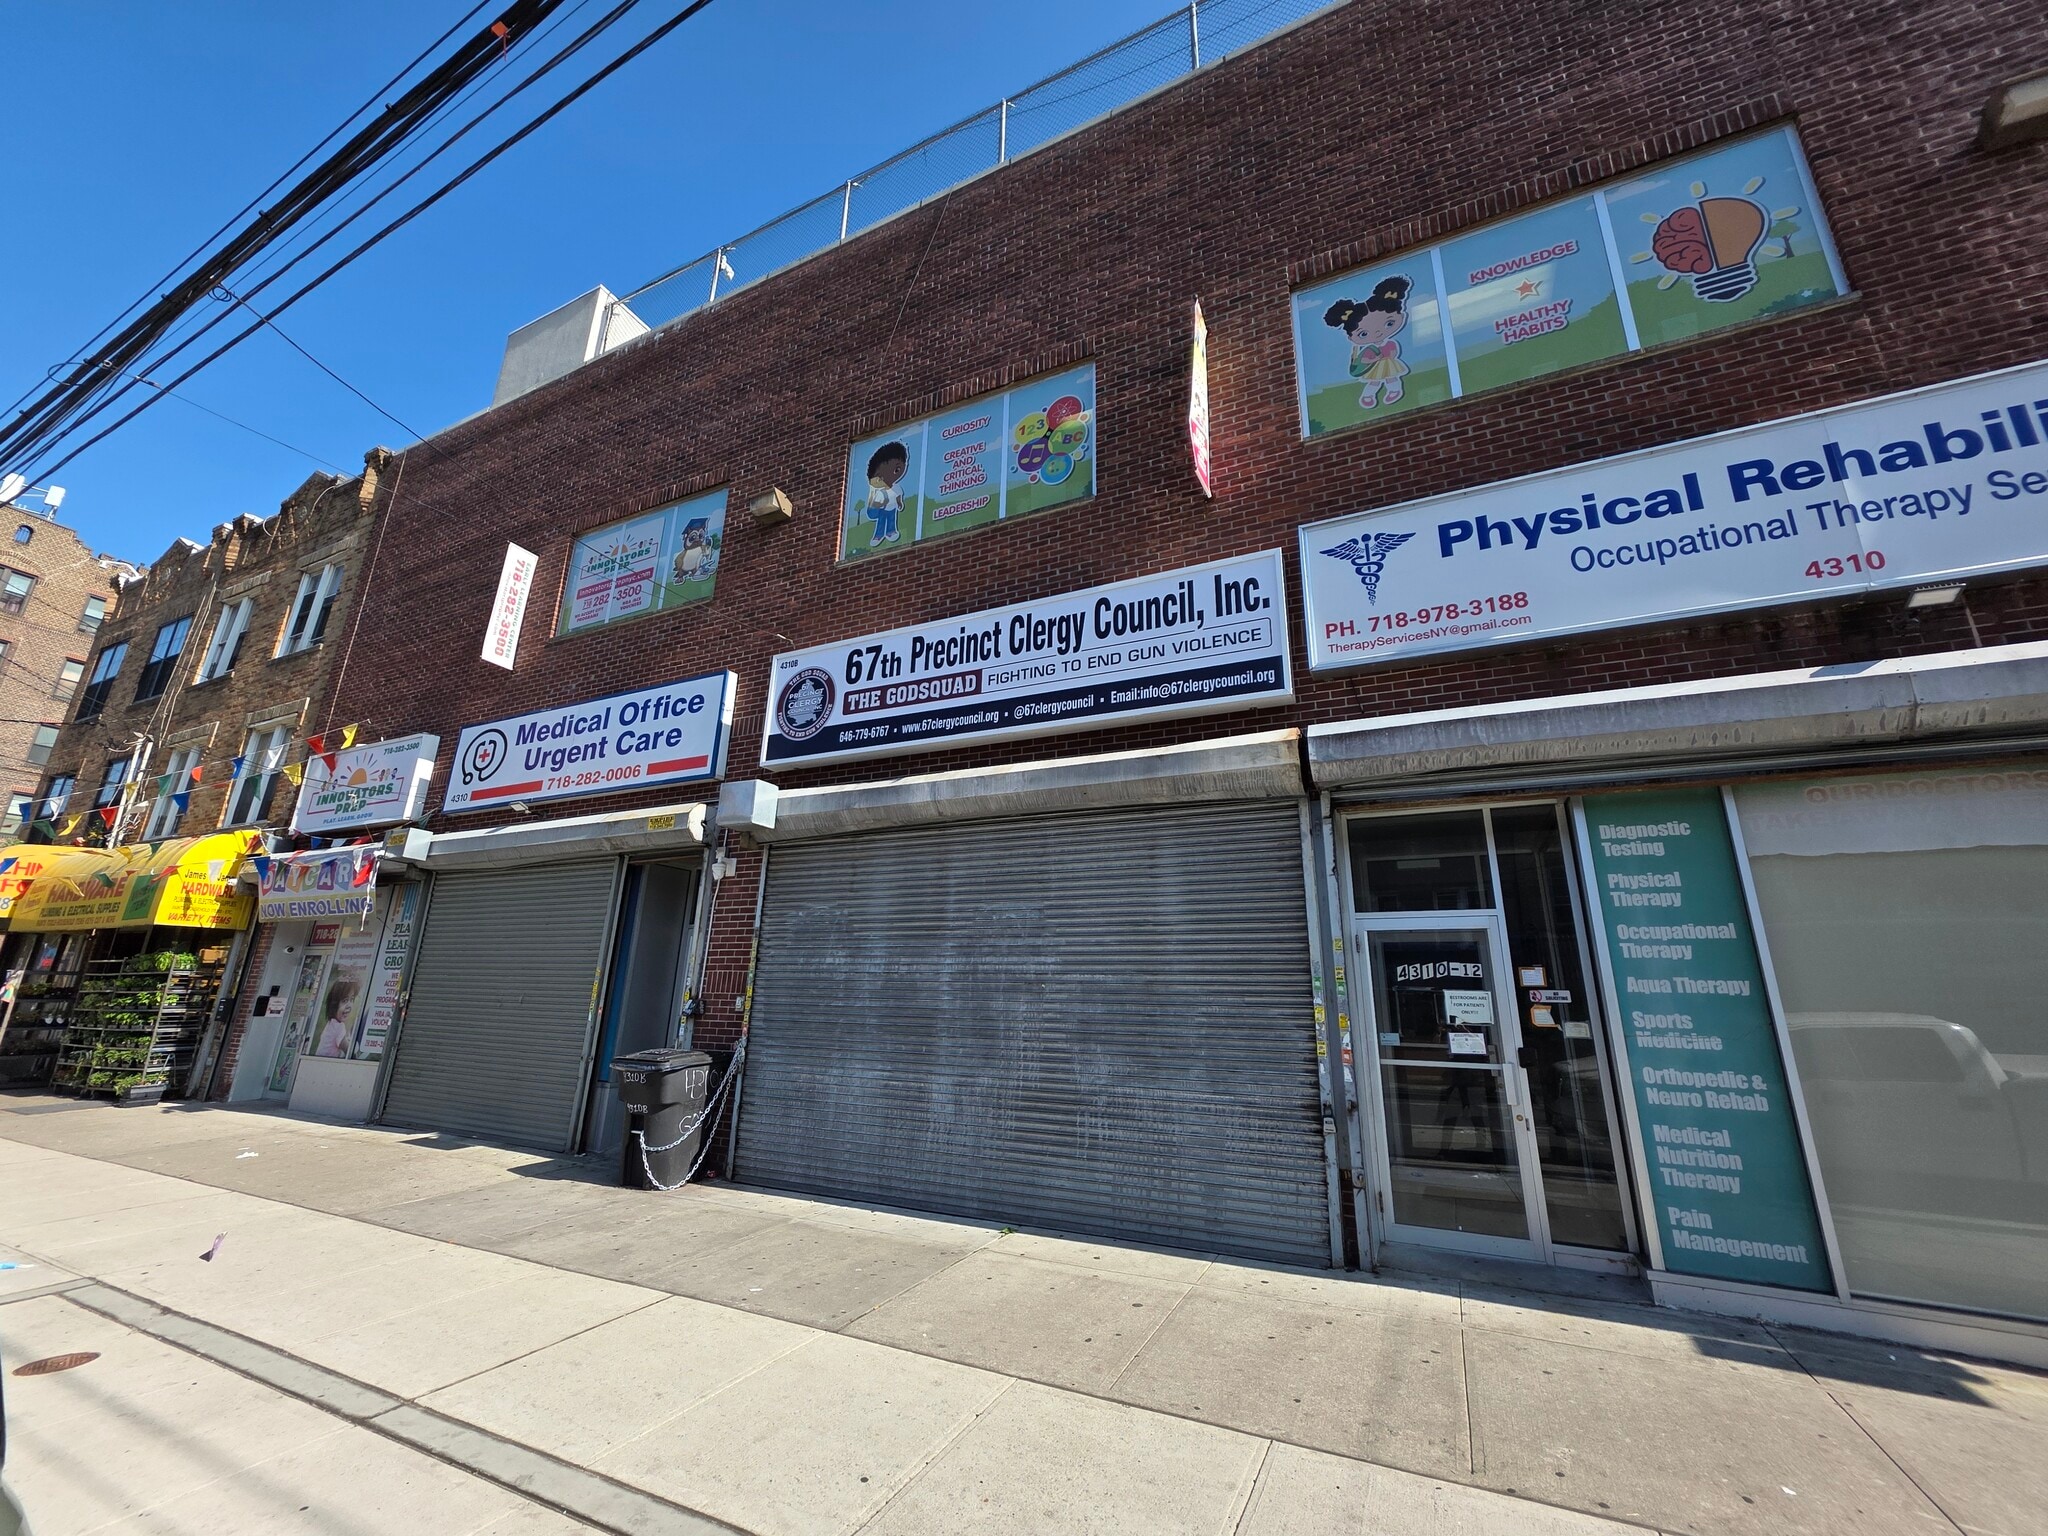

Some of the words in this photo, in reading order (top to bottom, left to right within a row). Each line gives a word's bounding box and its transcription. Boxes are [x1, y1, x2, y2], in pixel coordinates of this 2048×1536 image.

[1470, 241, 1577, 284] KNOWLEDGE
[1494, 300, 1572, 333] HEALTHY
[1502, 315, 1567, 344] HABITS
[942, 416, 990, 438] CURIOSITY
[1017, 419, 1046, 436] 123
[1052, 430, 1084, 445] ABC
[943, 443, 985, 461] CREATIVE
[953, 456, 974, 469] AND
[939, 474, 986, 495] THINKING
[943, 465, 982, 482] CRITICAL
[933, 496, 990, 519] LEADERSHIP
[1437, 472, 1704, 559] Physical
[1570, 508, 1798, 572] Occupational
[1806, 482, 1973, 532] Therapy
[1987, 466, 2048, 500] Se
[1805, 550, 1886, 580] 4310
[495, 559, 526, 656] 718-282-3500
[1325, 621, 1361, 640] PH.
[1368, 591, 1530, 633] 718-978-3188
[845, 644, 902, 685] 67th
[911, 626, 1002, 674] Precinct
[1009, 611, 1086, 656] Clergy
[1094, 579, 1204, 630] Council,
[1214, 573, 1271, 618] Inc.
[1328, 614, 1532, 654] TherapyServicesNY@gmail.com
[505, 629, 516, 659] CENTER
[780, 659, 799, 670] 4310B
[988, 663, 1056, 686] FIGHTING
[1061, 658, 1082, 673] TO
[1088, 651, 1121, 669] END
[1127, 644, 1165, 662] GUN
[1172, 627, 1262, 654] VIOLENCE
[788, 696, 824, 709] CLERGY
[789, 688, 824, 699] PRECINCT
[848, 691, 880, 711] THE
[886, 674, 977, 705] GODSQUAD
[515, 707, 612, 746] Medical
[619, 693, 705, 726] Office
[839, 725, 890, 743] 646-779-6767
[902, 711, 1000, 734] www.67clergycouncil.org
[1013, 694, 1094, 720] @67clergycouncil
[524, 736, 608, 772] Urgent
[615, 727, 682, 756] Care
[547, 764, 641, 790] 718-282-0006
[316, 783, 394, 806] INNOVATORS
[450, 793, 468, 803] 4310
[1806, 783, 1875, 806] OUR
[334, 800, 367, 814] PREP
[1599, 821, 1691, 840] Diagnostic
[1601, 841, 1665, 857] Testing
[185, 868, 207, 880] James
[1607, 872, 1682, 889] Physical
[261, 903, 286, 918] NOW
[289, 897, 373, 916] ENROLLING
[1610, 891, 1682, 907] Therapy
[168, 912, 205, 922] VARIETY
[206, 914, 232, 924] ITEMS
[394, 923, 411, 934] PLA
[1616, 922, 1737, 941] Occupational
[384, 956, 404, 967] GRO
[1619, 942, 1693, 960] Therapy
[1397, 962, 1482, 980] 4310-12
[1626, 976, 1672, 995] Aqua
[1673, 976, 1750, 997] Therapy
[1631, 1011, 1694, 1030] Sports
[1635, 1031, 1723, 1051] Medicine
[1642, 1066, 1749, 1090] Orthopedic
[1751, 1074, 1768, 1091] &
[1646, 1087, 1702, 1108] Neuro
[1705, 1090, 1769, 1112] Rehab
[1653, 1124, 1732, 1148] Medical
[1656, 1146, 1743, 1171] Nutrition
[1660, 1167, 1741, 1194] Therapy
[1667, 1206, 1713, 1230] Pain
[1672, 1229, 1809, 1264] Management
